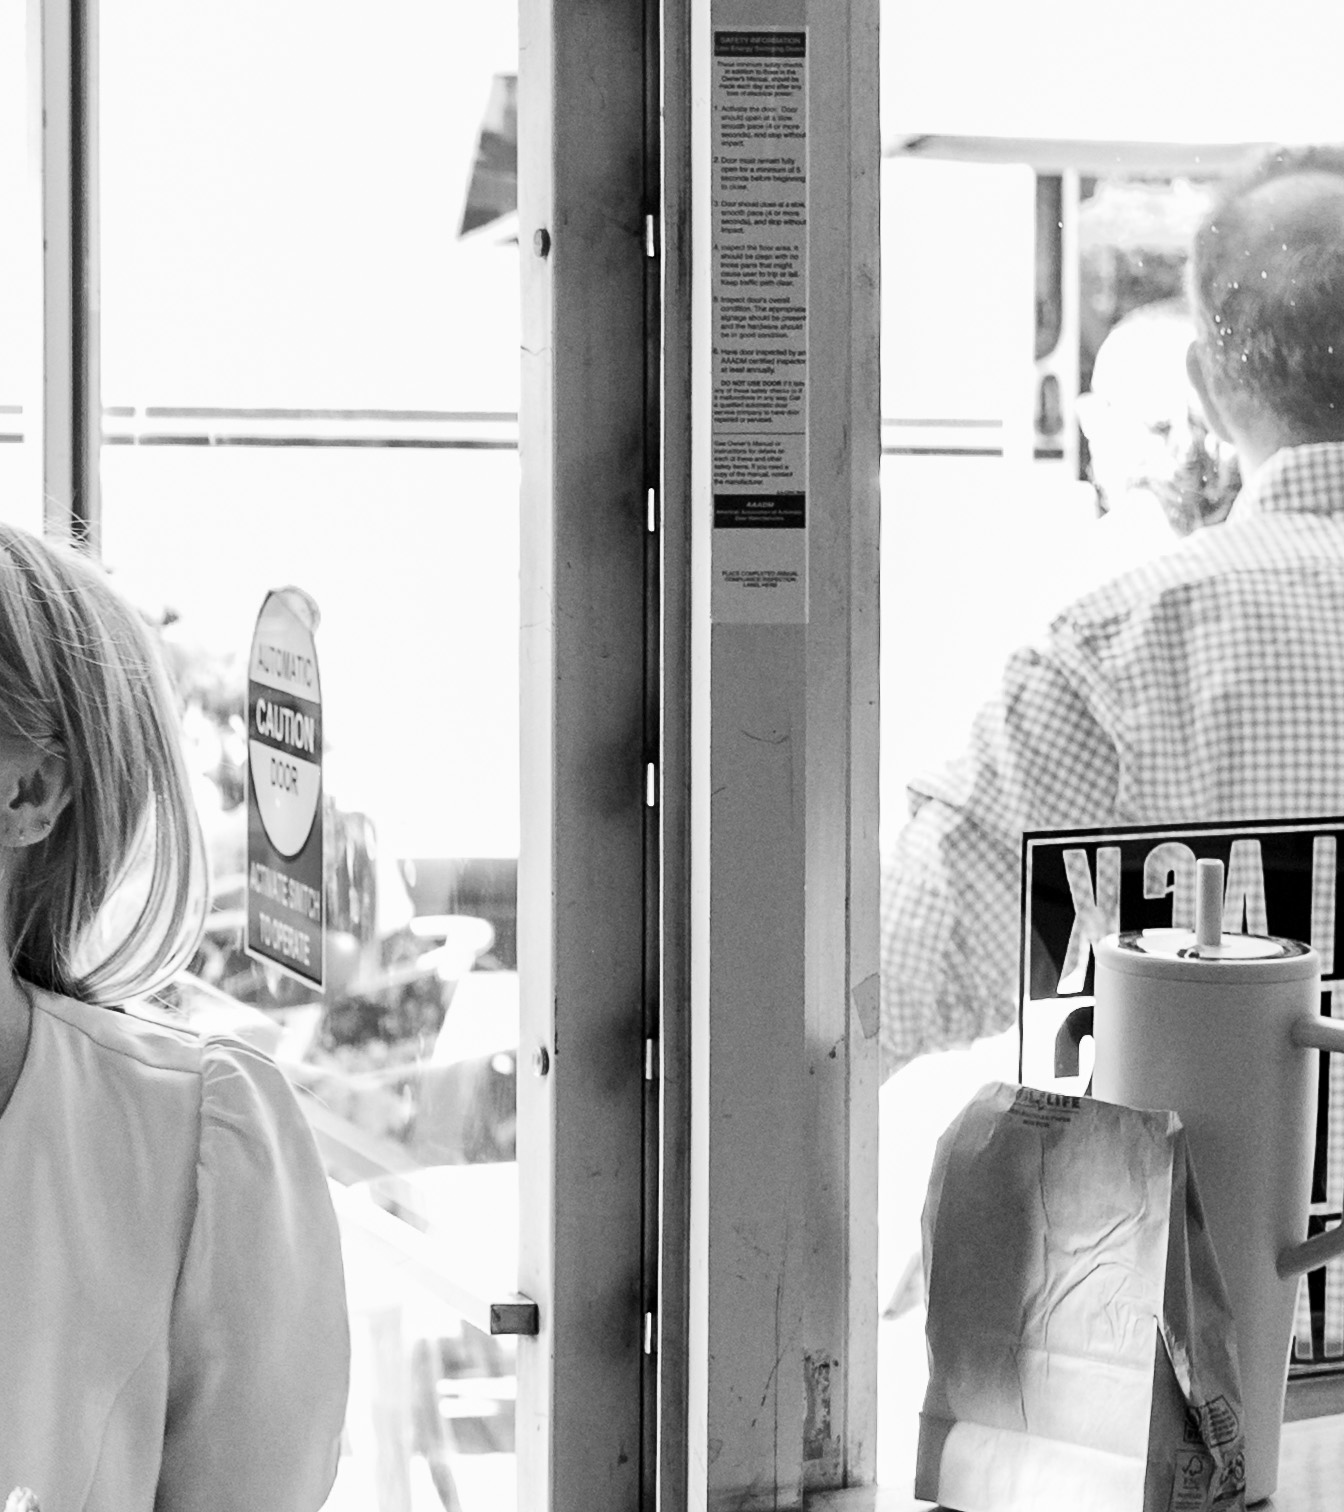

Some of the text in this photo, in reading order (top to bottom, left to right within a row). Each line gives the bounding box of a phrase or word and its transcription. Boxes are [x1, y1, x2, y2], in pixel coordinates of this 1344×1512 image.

[256, 643, 313, 688] AUTOMATIC
[255, 697, 316, 755] CAUTION
[270, 757, 299, 796] DOOR
[259, 912, 311, 967] TO OPERATE
